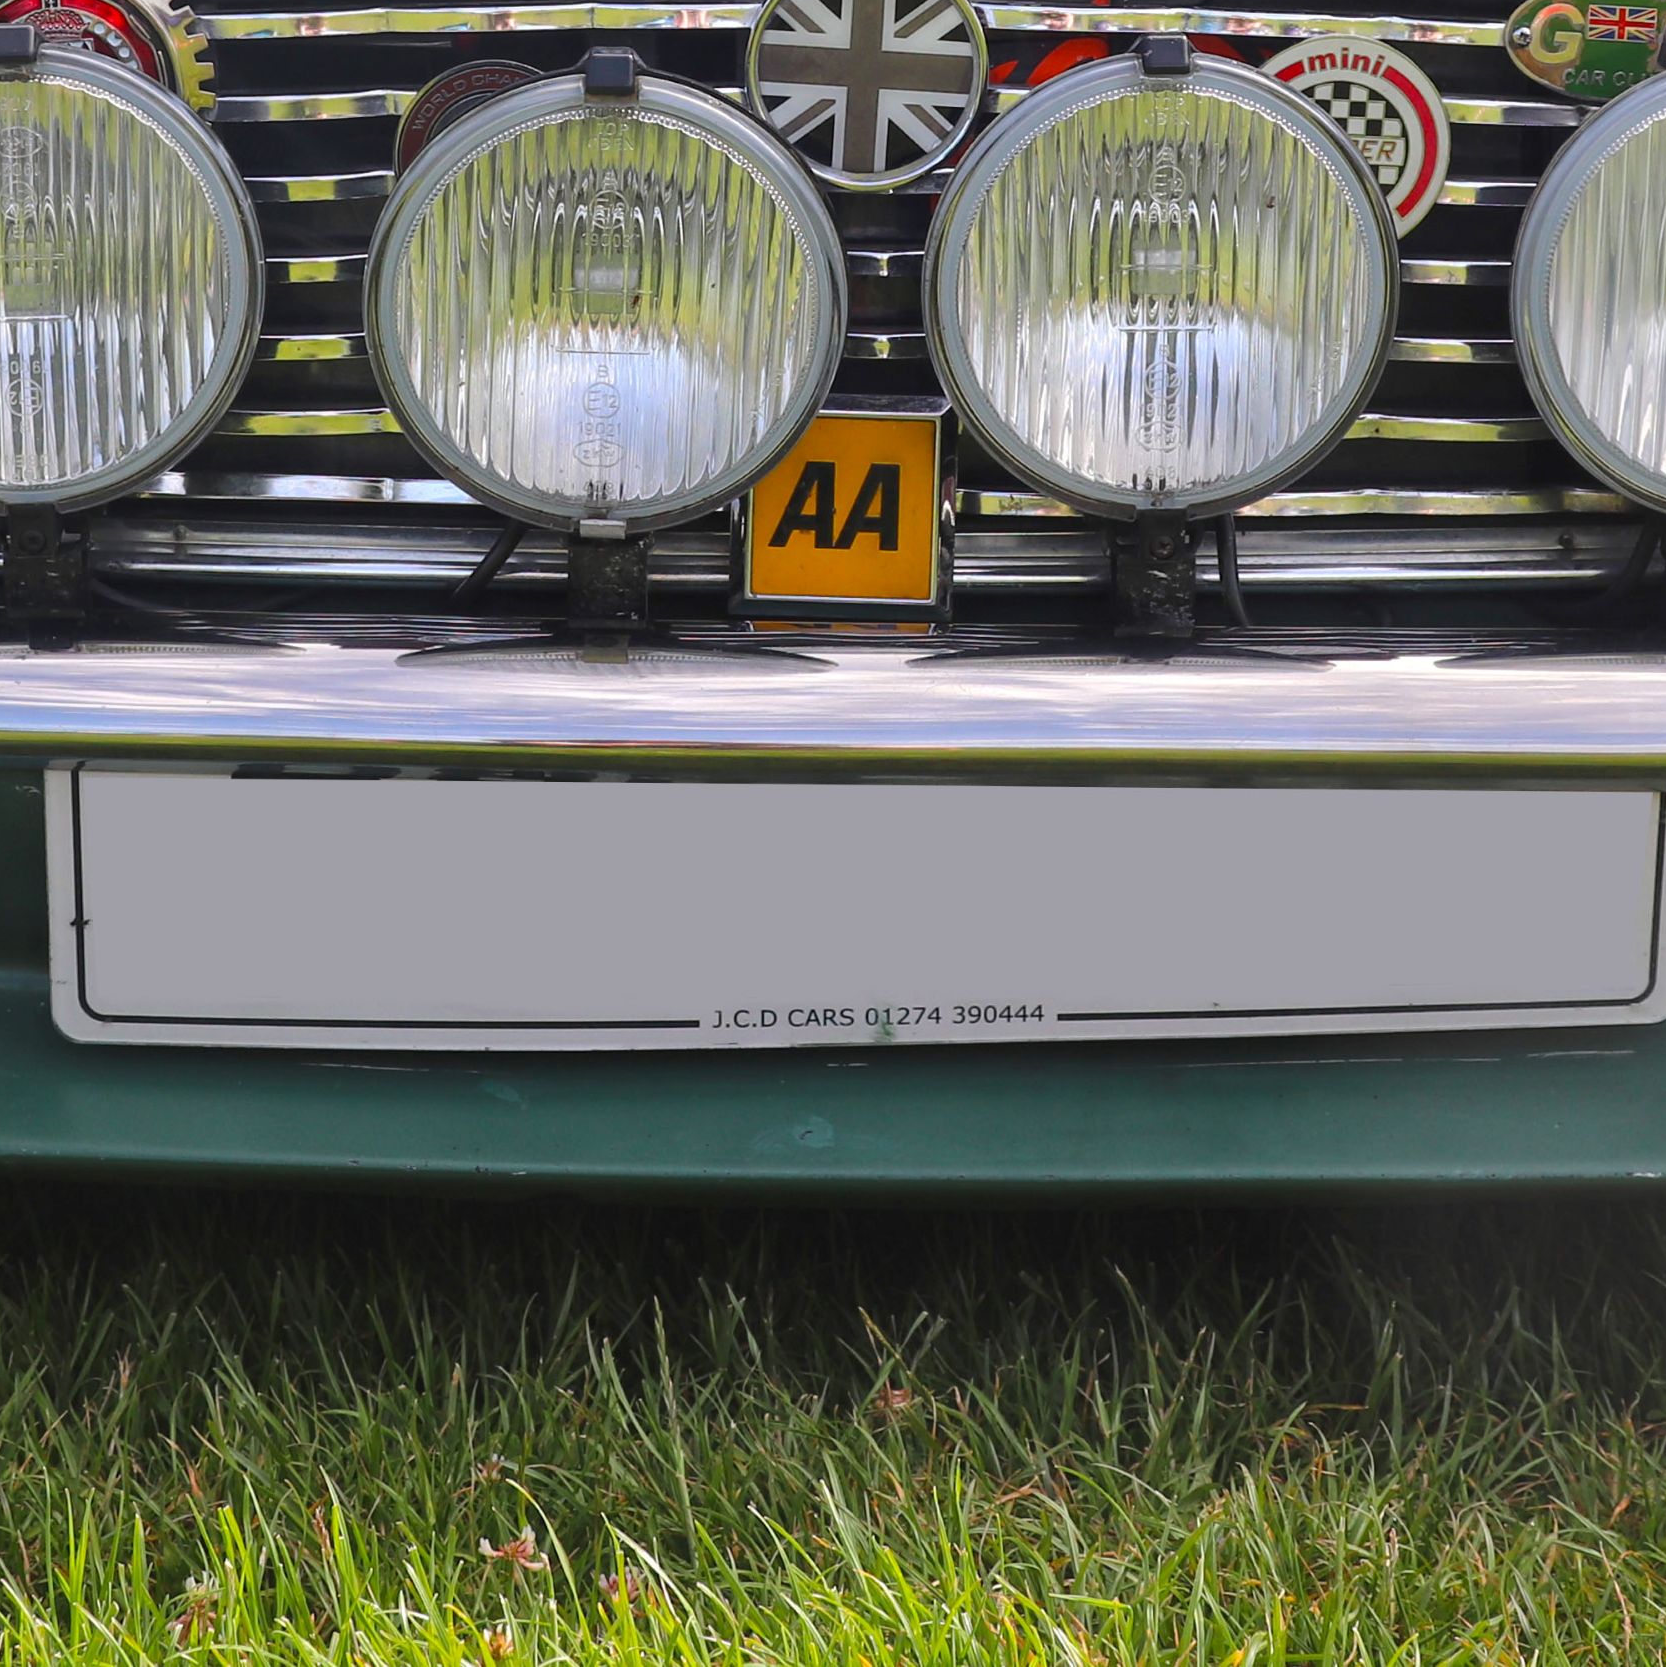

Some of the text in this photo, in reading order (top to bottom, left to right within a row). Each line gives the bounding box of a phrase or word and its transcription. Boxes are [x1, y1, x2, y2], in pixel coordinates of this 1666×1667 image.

[1307, 47, 1386, 77] mini
[1561, 68, 1606, 86] CAR
[413, 79, 468, 130] WORLD
[768, 460, 902, 552] AA
[712, 1004, 1045, 1029] J.C.D CARS 01274 390444
